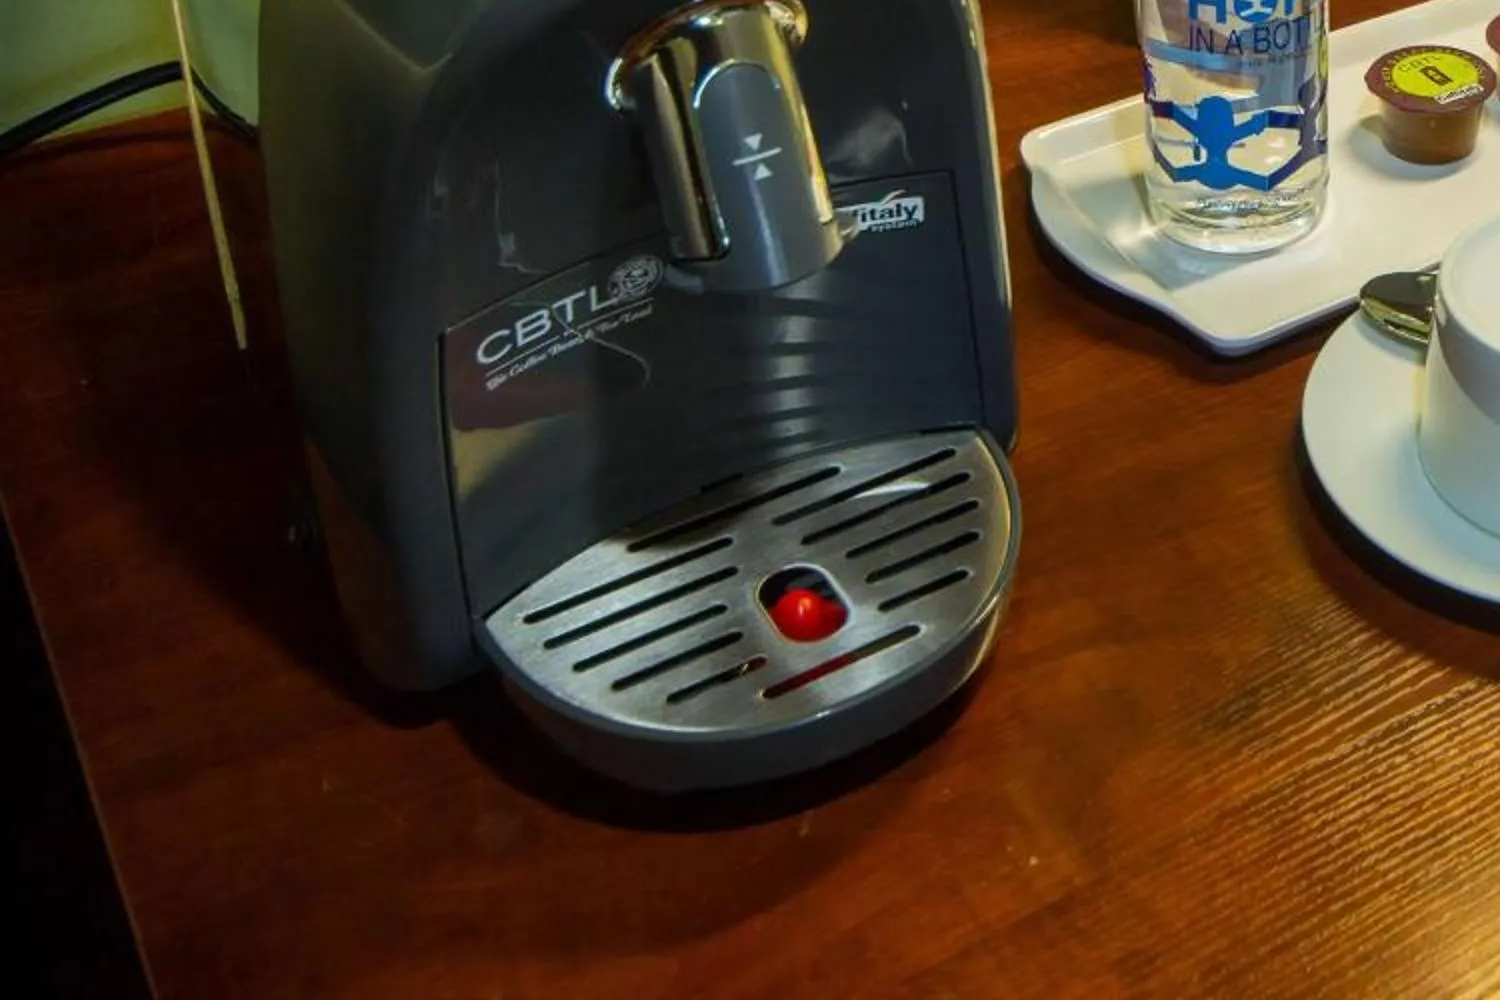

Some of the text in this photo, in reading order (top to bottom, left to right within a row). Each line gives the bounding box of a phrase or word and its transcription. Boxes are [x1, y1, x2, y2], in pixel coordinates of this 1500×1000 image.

[1189, 22, 1215, 55] IN
[1224, 29, 1244, 54] A
[477, 285, 623, 365] CBTL
